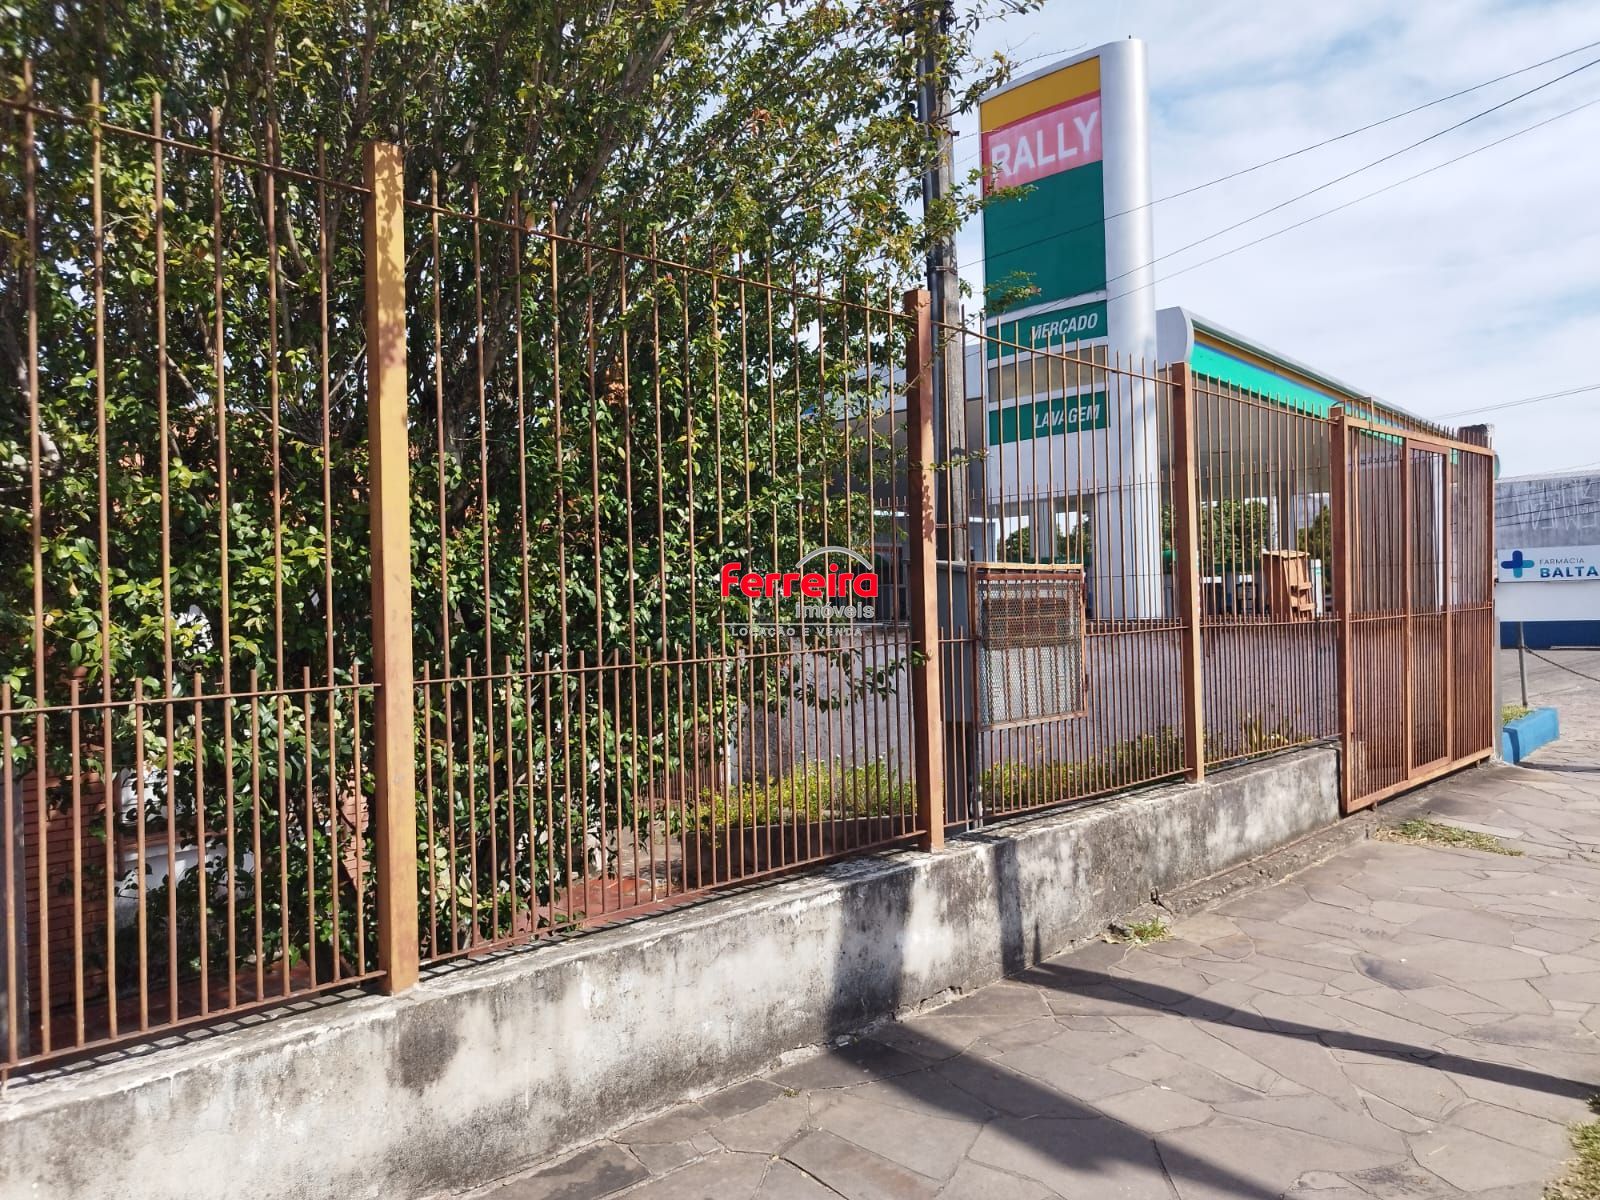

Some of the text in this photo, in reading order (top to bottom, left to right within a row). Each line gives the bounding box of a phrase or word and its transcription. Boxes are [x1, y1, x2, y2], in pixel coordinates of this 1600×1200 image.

[991, 111, 1099, 178] RALLY
[1031, 312, 1098, 341] MERCADO
[1540, 565, 1599, 578] BALTA
